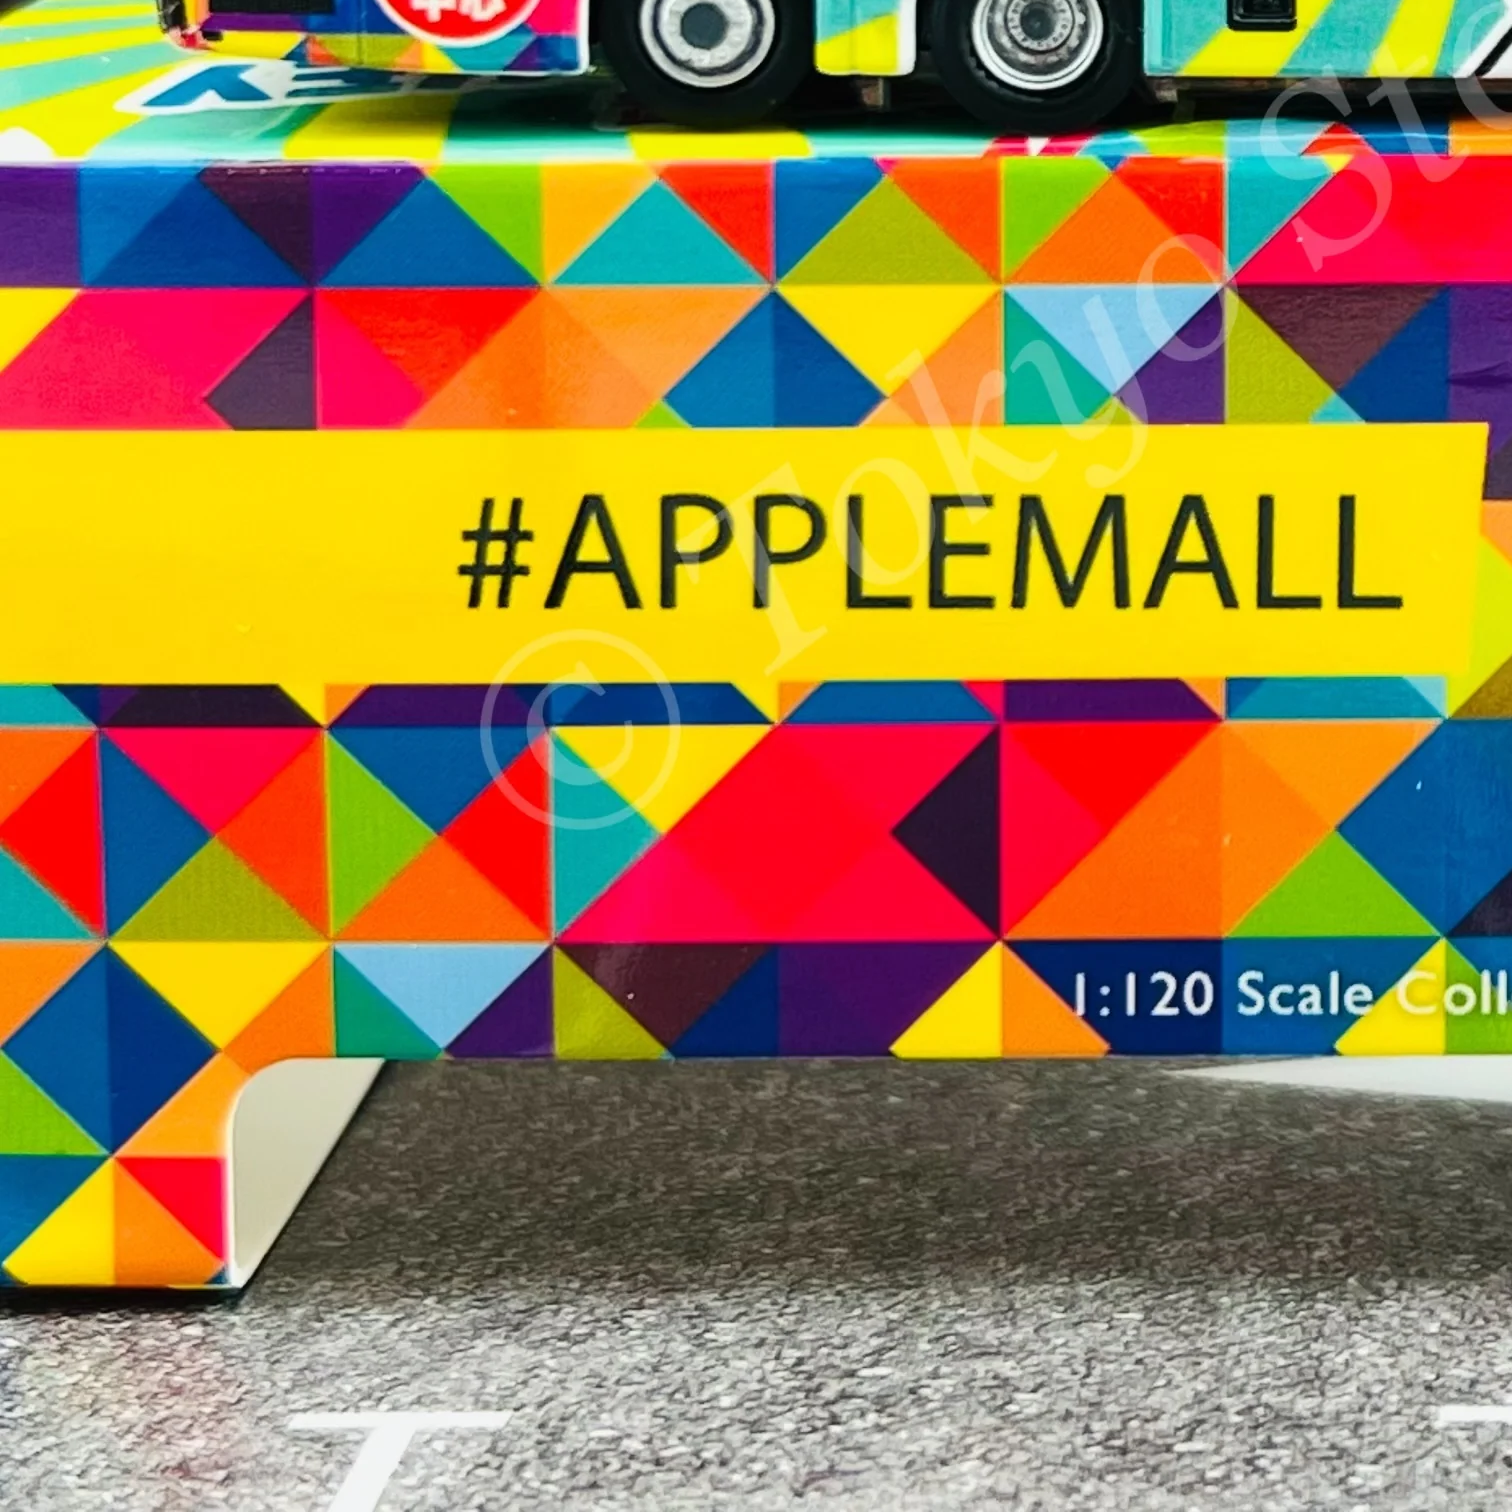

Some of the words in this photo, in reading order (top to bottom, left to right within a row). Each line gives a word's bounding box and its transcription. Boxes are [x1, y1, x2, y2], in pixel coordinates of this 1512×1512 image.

[457, 493, 1404, 610] #APPLEMALL
[1074, 970, 1214, 1016] 1:120
[1237, 970, 1374, 1016] Scale
